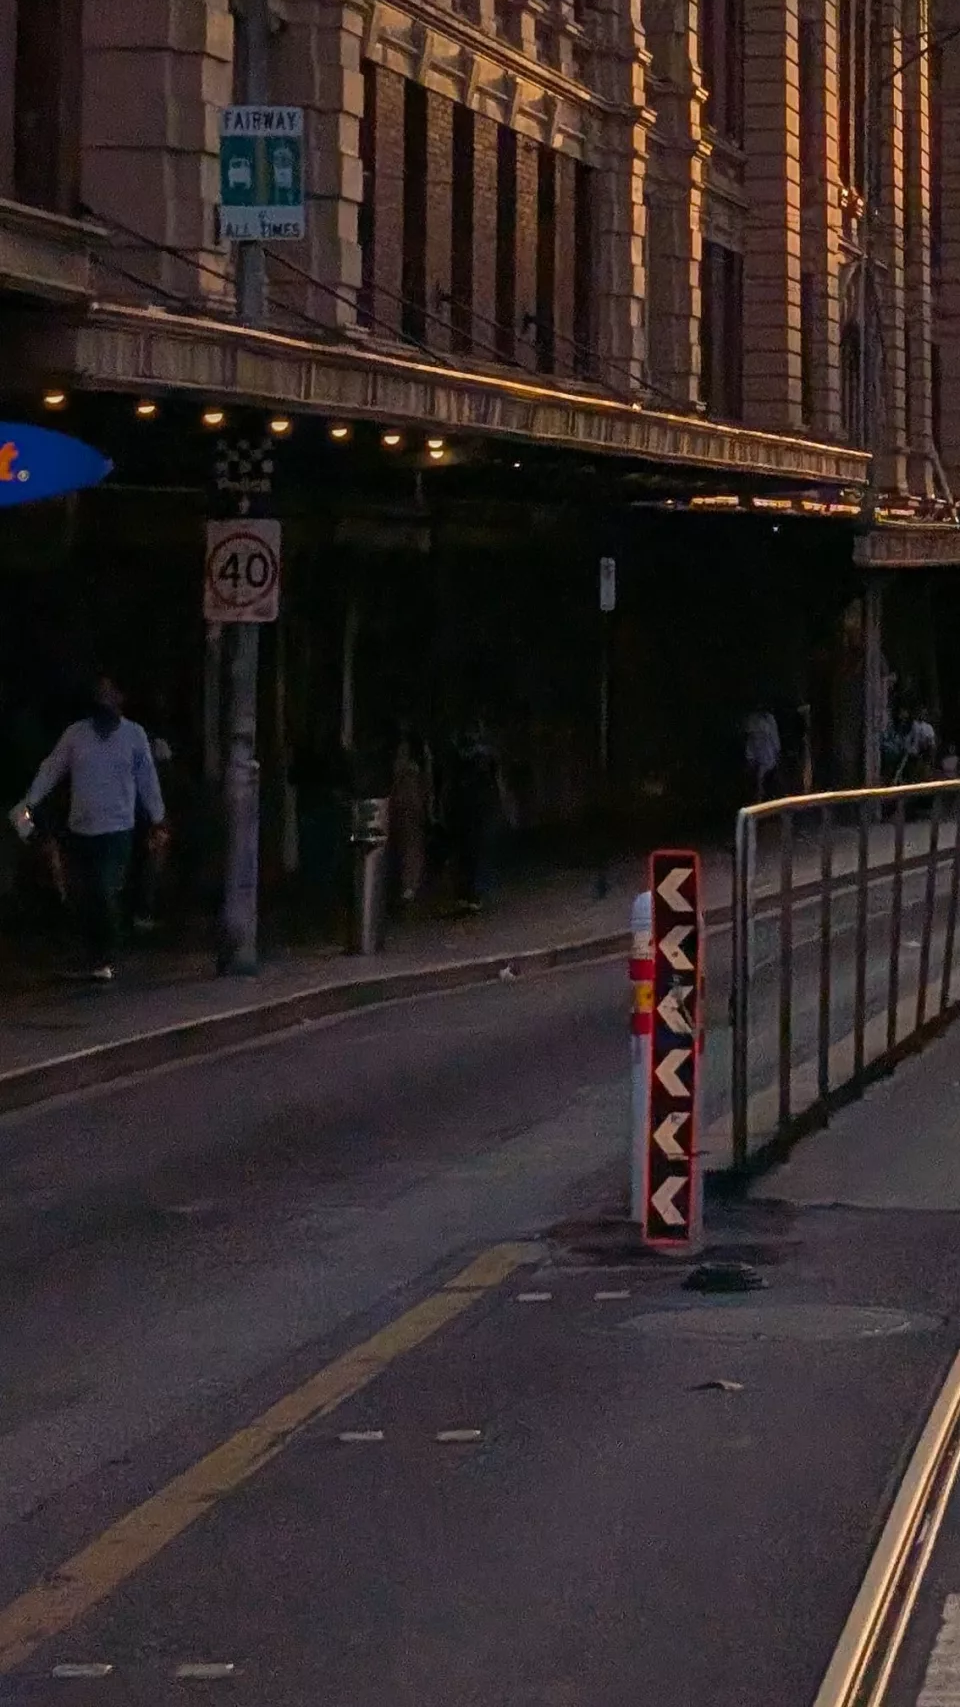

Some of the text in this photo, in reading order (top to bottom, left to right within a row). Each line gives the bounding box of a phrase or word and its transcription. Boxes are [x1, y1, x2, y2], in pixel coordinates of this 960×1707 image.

[223, 111, 297, 130] FAIRWAY
[226, 223, 300, 237] ALL TIMES
[219, 552, 270, 588] 40
